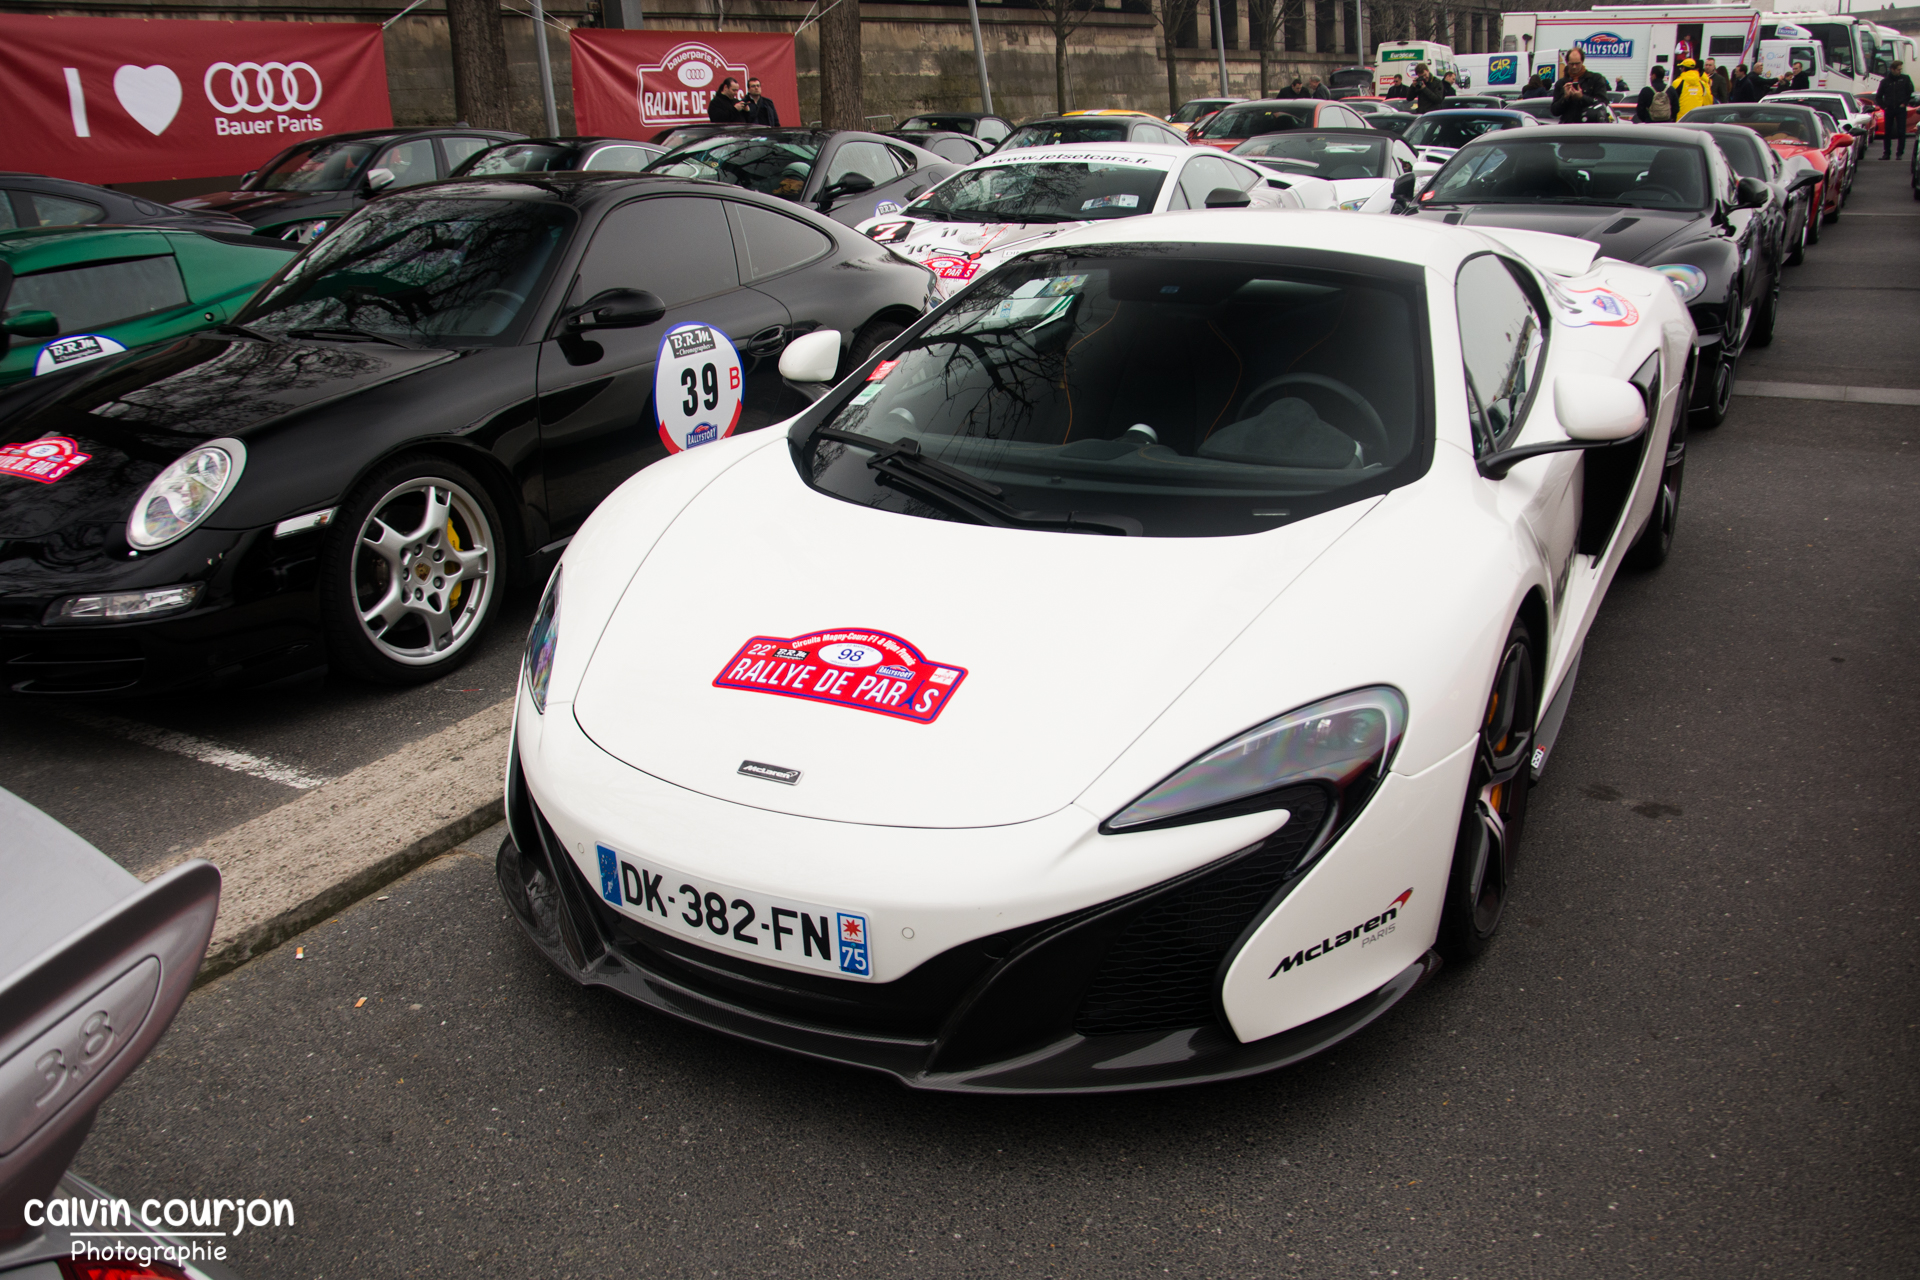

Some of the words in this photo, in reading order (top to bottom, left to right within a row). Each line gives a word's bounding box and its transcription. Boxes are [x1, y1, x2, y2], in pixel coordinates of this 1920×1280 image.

[667, 51, 721, 71] bauerparis.fr
[1490, 58, 1510, 71] CAR
[1538, 66, 1552, 75] CAR
[62, 67, 91, 137] I
[644, 91, 690, 116] RALLYE
[691, 90, 708, 114] DE
[215, 117, 275, 135] Bauer
[277, 113, 324, 132] Paris
[992, 152, 1152, 165] www.jetsetcars.fr
[873, 221, 907, 240] 7
[729, 366, 741, 390] B
[680, 362, 719, 417] 39
[688, 426, 717, 445] RALLYSTORY
[792, 636, 821, 649] Circuits
[822, 632, 869, 642] Magny-Cours
[866, 634, 880, 643] F1
[876, 637, 887, 645] &
[882, 640, 900, 652] Dijon
[838, 648, 864, 662] 98
[727, 657, 817, 690] RALLYE
[812, 668, 855, 696] DE
[878, 666, 913, 679] RALLYSTORY
[742, 764, 790, 779] McLaren
[620, 859, 832, 961] DK-382-FN
[1267, 907, 1398, 980] McLaren
[1361, 922, 1396, 948] PARIS
[841, 945, 867, 970] 75
[35, 1009, 117, 1109] 3.8
